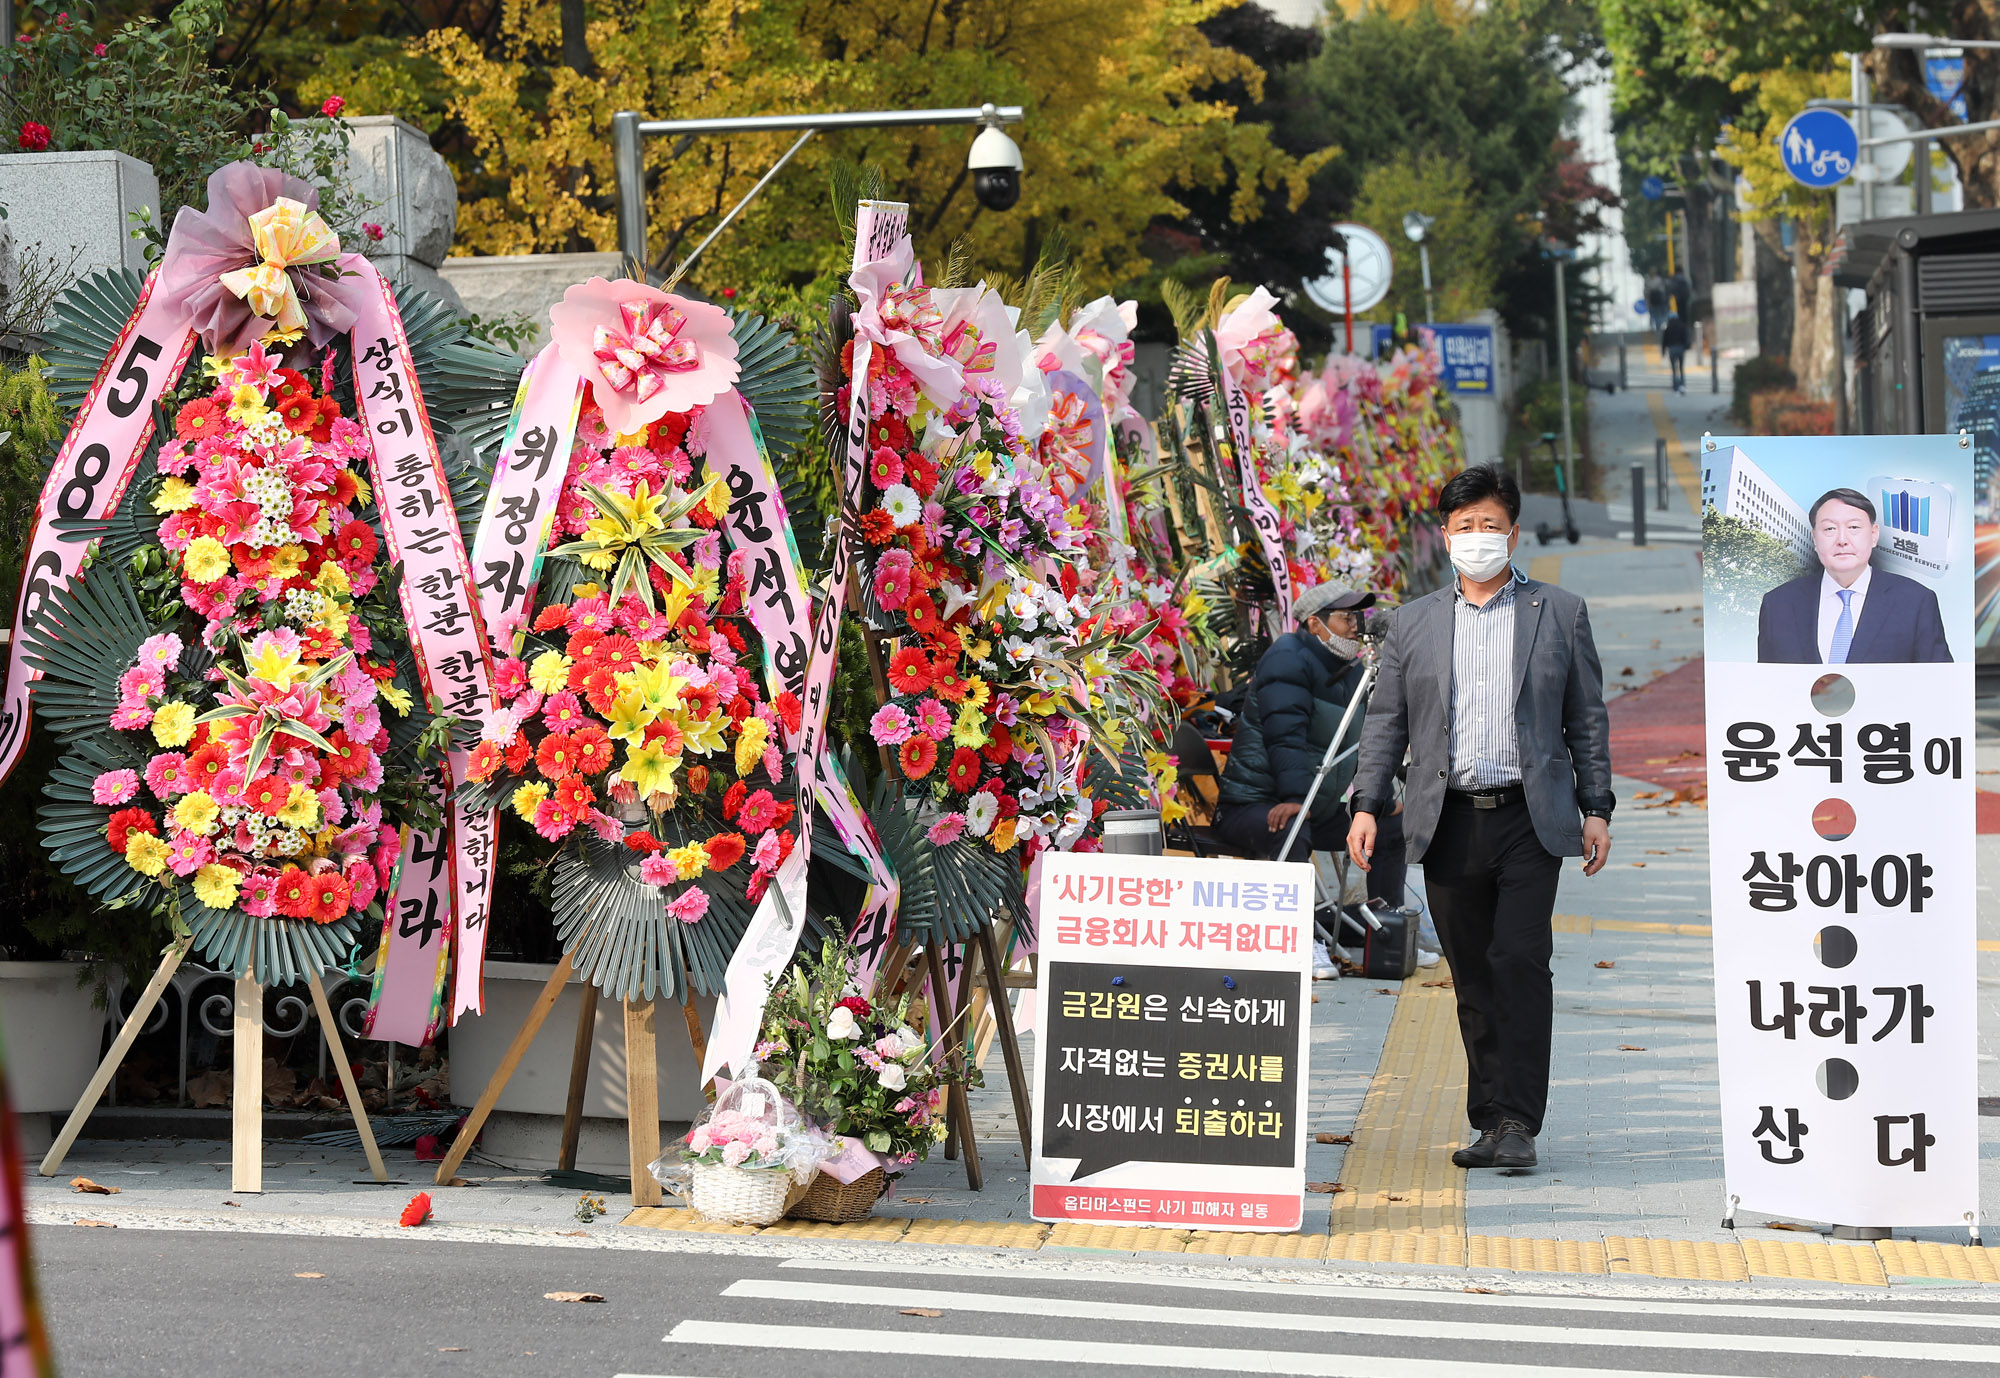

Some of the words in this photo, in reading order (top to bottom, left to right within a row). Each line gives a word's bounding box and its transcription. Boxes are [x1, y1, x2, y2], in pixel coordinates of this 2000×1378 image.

[359, 337, 414, 438] 상식이
[386, 453, 451, 553] 통하는
[1892, 536, 1919, 555] 검찰
[1914, 557, 1941, 571] SERVICE
[434, 650, 490, 749] 한분
[1722, 721, 1962, 784] 윤석열이
[1052, 874, 1184, 907] ‘사기당한’
[1192, 880, 1299, 912] NH증권
[1742, 851, 1934, 914] 살아야
[1056, 916, 1169, 949] 금융회사
[1178, 921, 1298, 953] 자격없다!
[1062, 990, 1169, 1021] 금감원은
[1179, 995, 1286, 1027] 신속하게
[1745, 979, 1935, 1045] 나라가
[1059, 1046, 1166, 1078] 자격없는
[1177, 1051, 1284, 1083] 증권사를
[1056, 1102, 1164, 1134] 시장에서
[1175, 1106, 1284, 1139] 퇴출하라
[1064, 1194, 1152, 1215] 옵티머스펀드
[1156, 1199, 1187, 1216] 사기
[1191, 1201, 1236, 1218] 피해자
[1240, 1202, 1269, 1219] 일동
